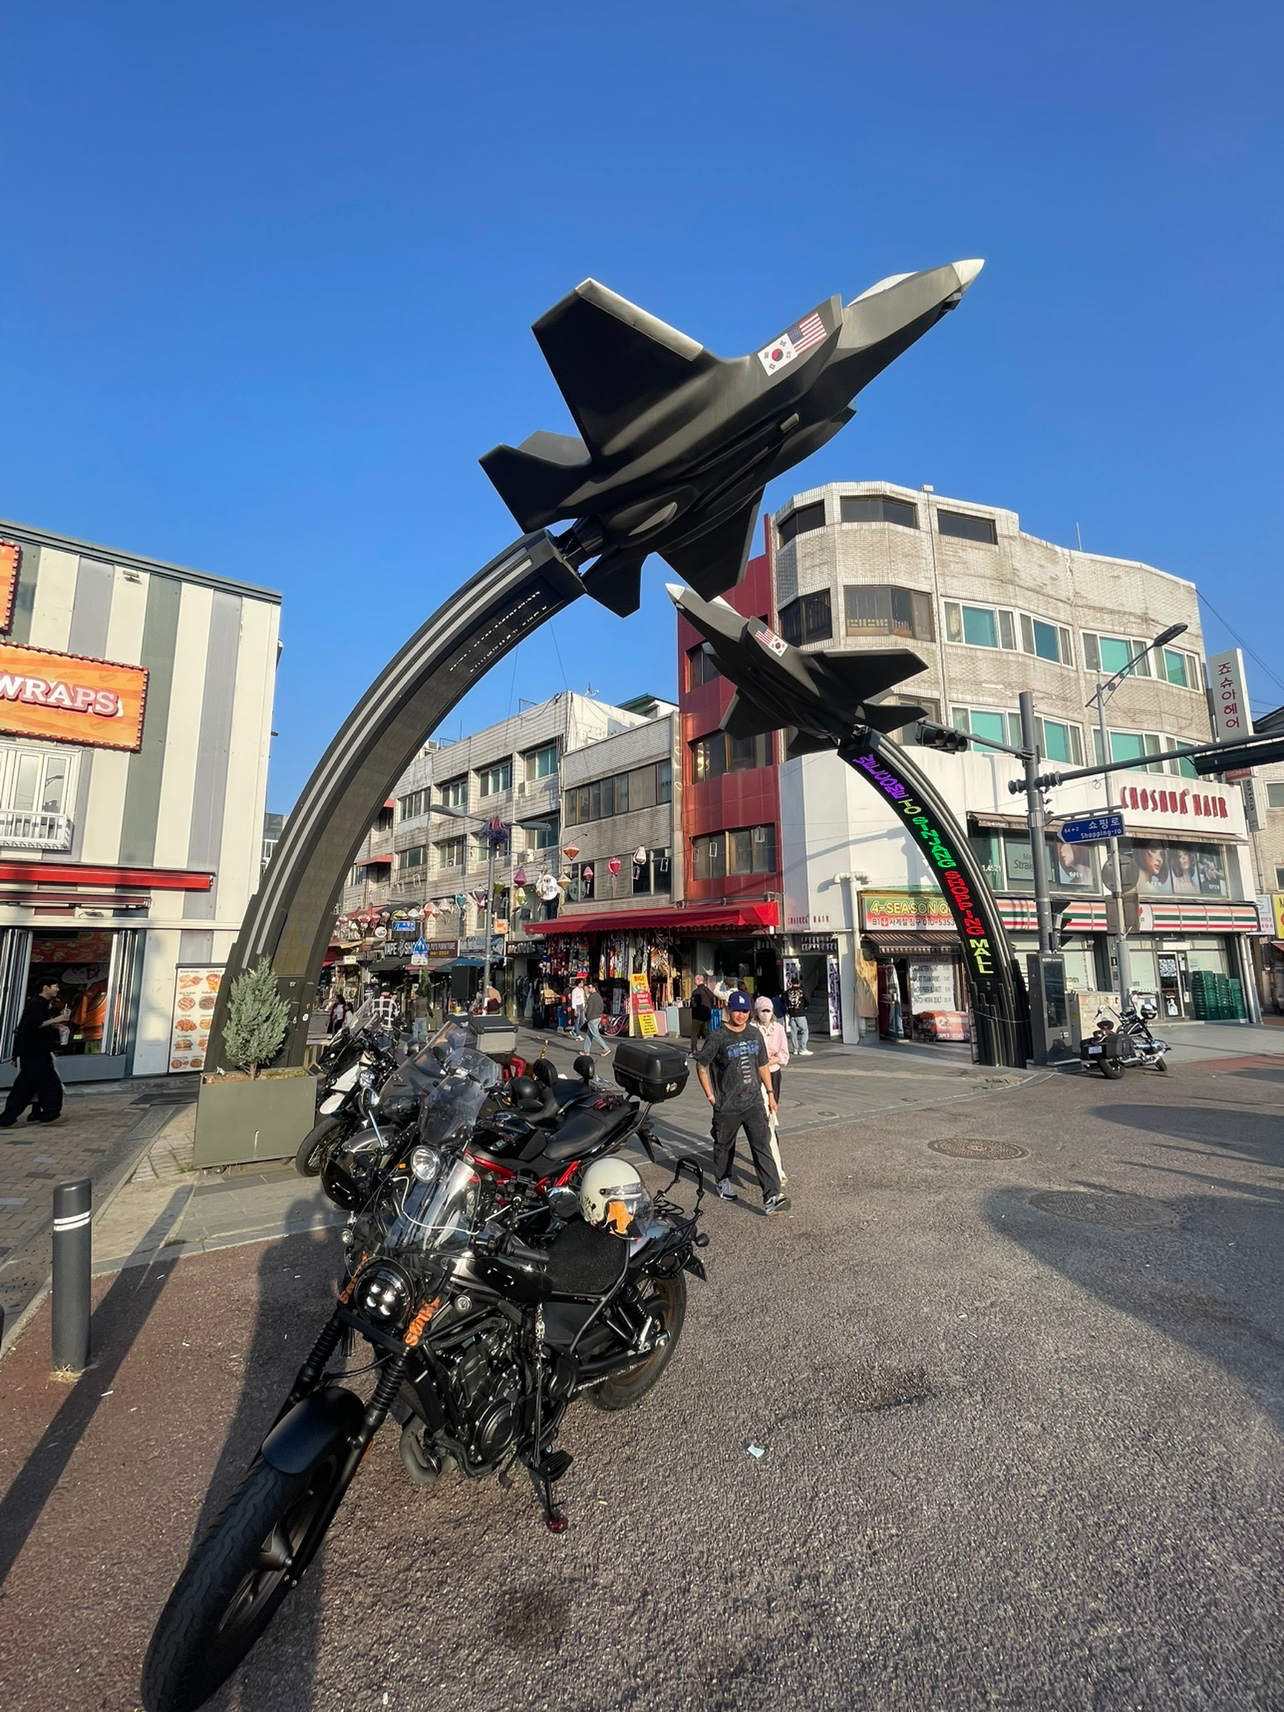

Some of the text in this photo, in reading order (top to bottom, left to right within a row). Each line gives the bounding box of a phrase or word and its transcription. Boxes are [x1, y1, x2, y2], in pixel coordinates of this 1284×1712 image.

[0, 674, 119, 716] WRAPS
[1192, 793, 1228, 819] HAIR
[1080, 828, 1122, 840] Shopping-ro
[852, 754, 994, 975] WELCOME TO SINJANG SHOPPING MALL
[871, 900, 936, 915] 4-SEASON
[872, 918, 881, 927] B1
